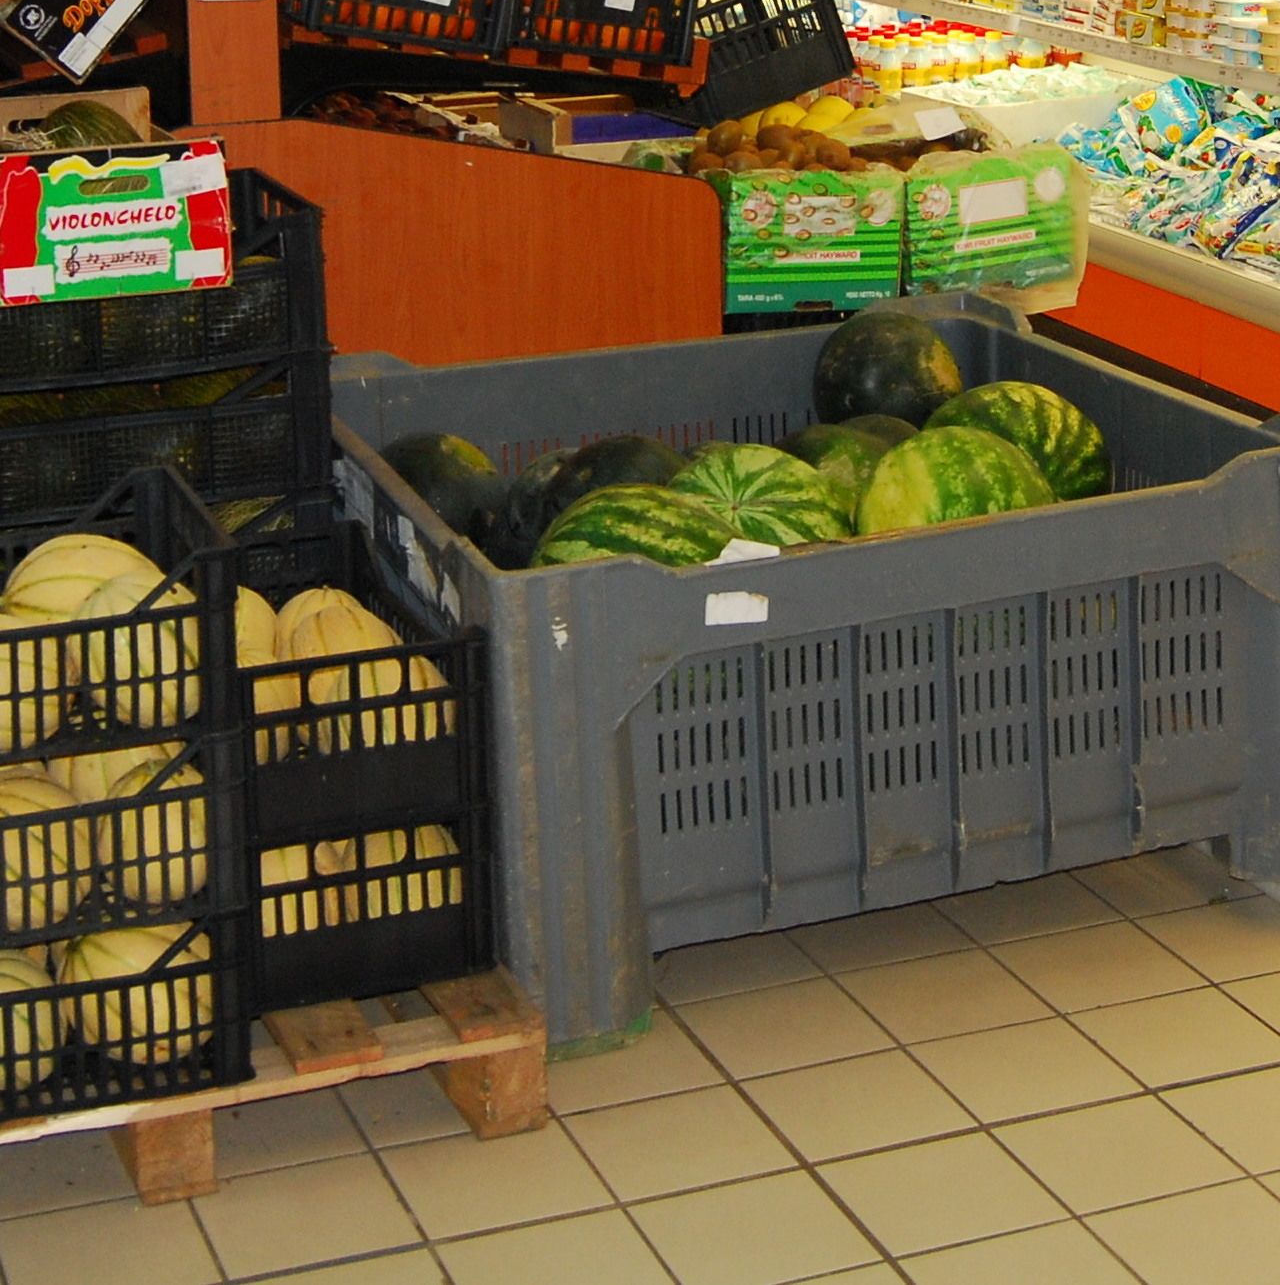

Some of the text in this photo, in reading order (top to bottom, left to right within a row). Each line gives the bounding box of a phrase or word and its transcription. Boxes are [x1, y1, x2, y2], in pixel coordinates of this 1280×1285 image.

[48, 204, 176, 231] VIOLONCHELO
[996, 231, 1034, 245] HAYWARD
[820, 251, 858, 260] HAYWARD
